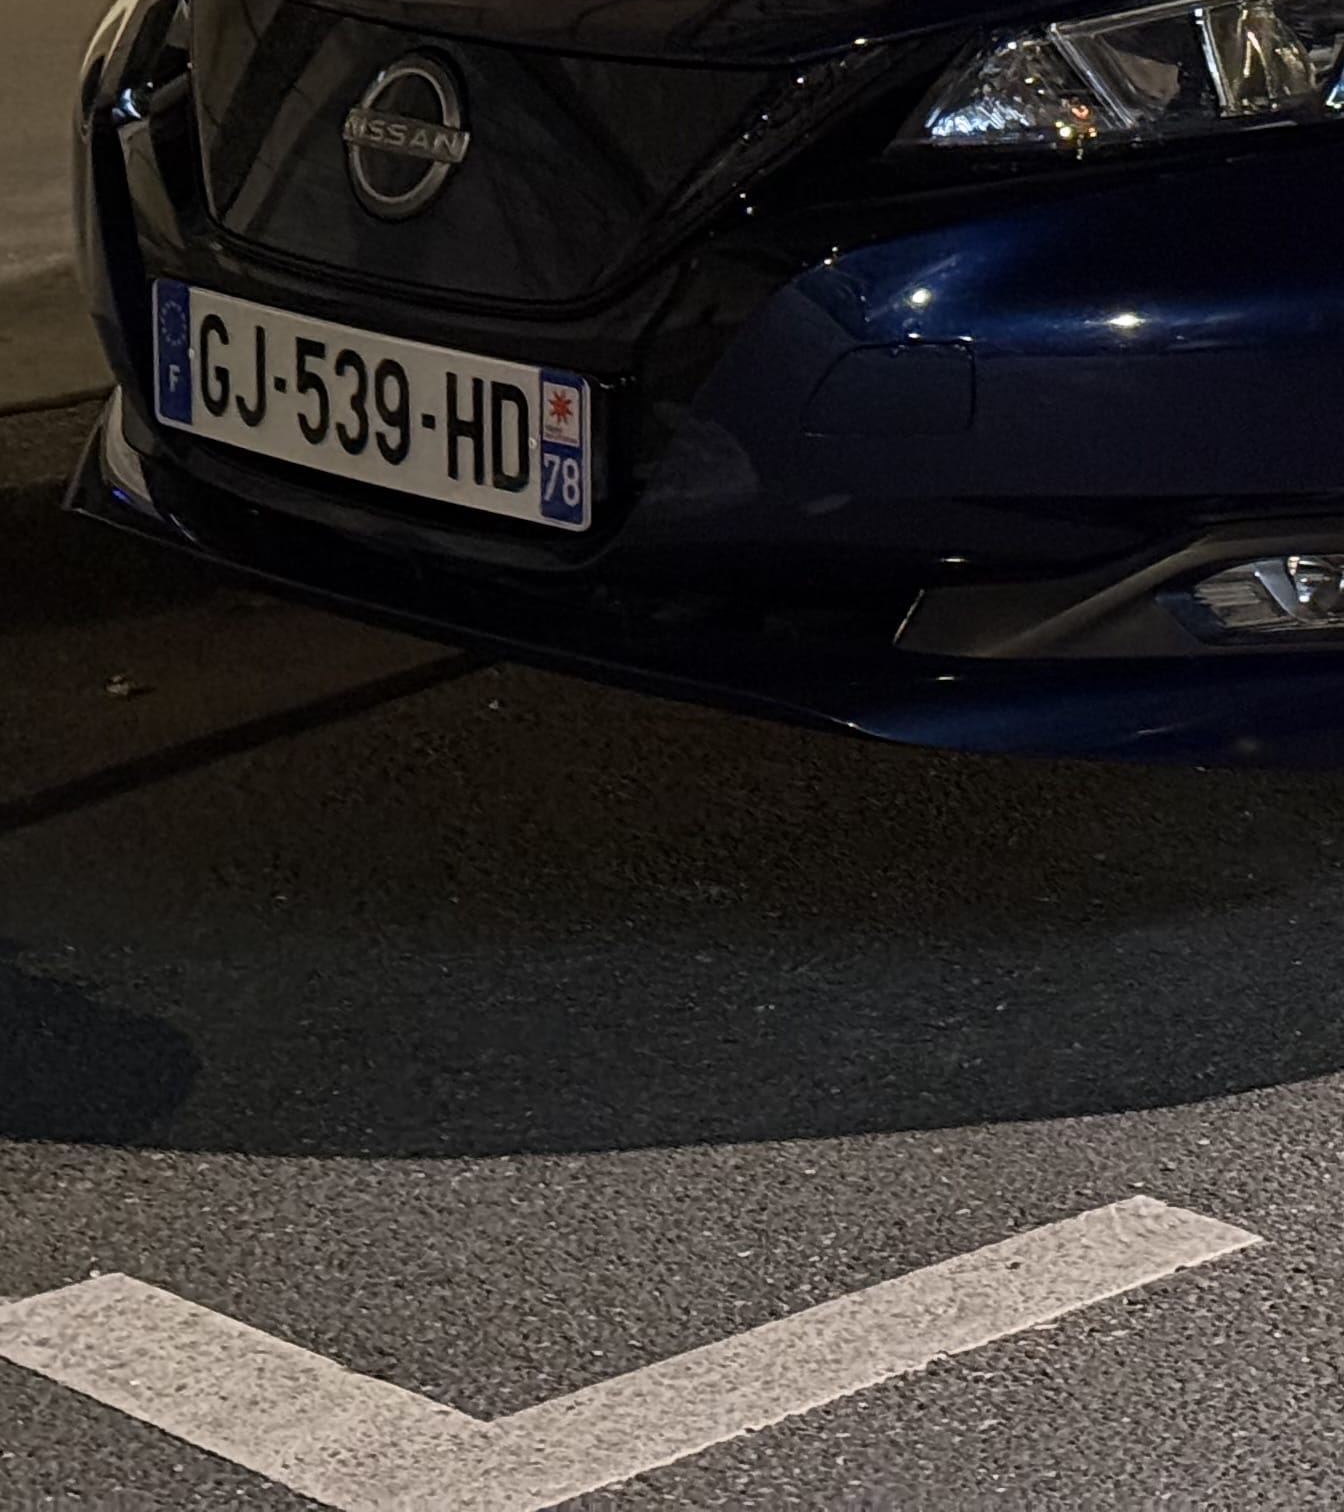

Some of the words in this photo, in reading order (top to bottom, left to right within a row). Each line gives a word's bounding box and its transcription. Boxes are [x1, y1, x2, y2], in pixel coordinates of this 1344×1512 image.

[168, 364, 181, 392] F
[199, 314, 531, 493] GJ-539-HD
[543, 452, 581, 507] 78
